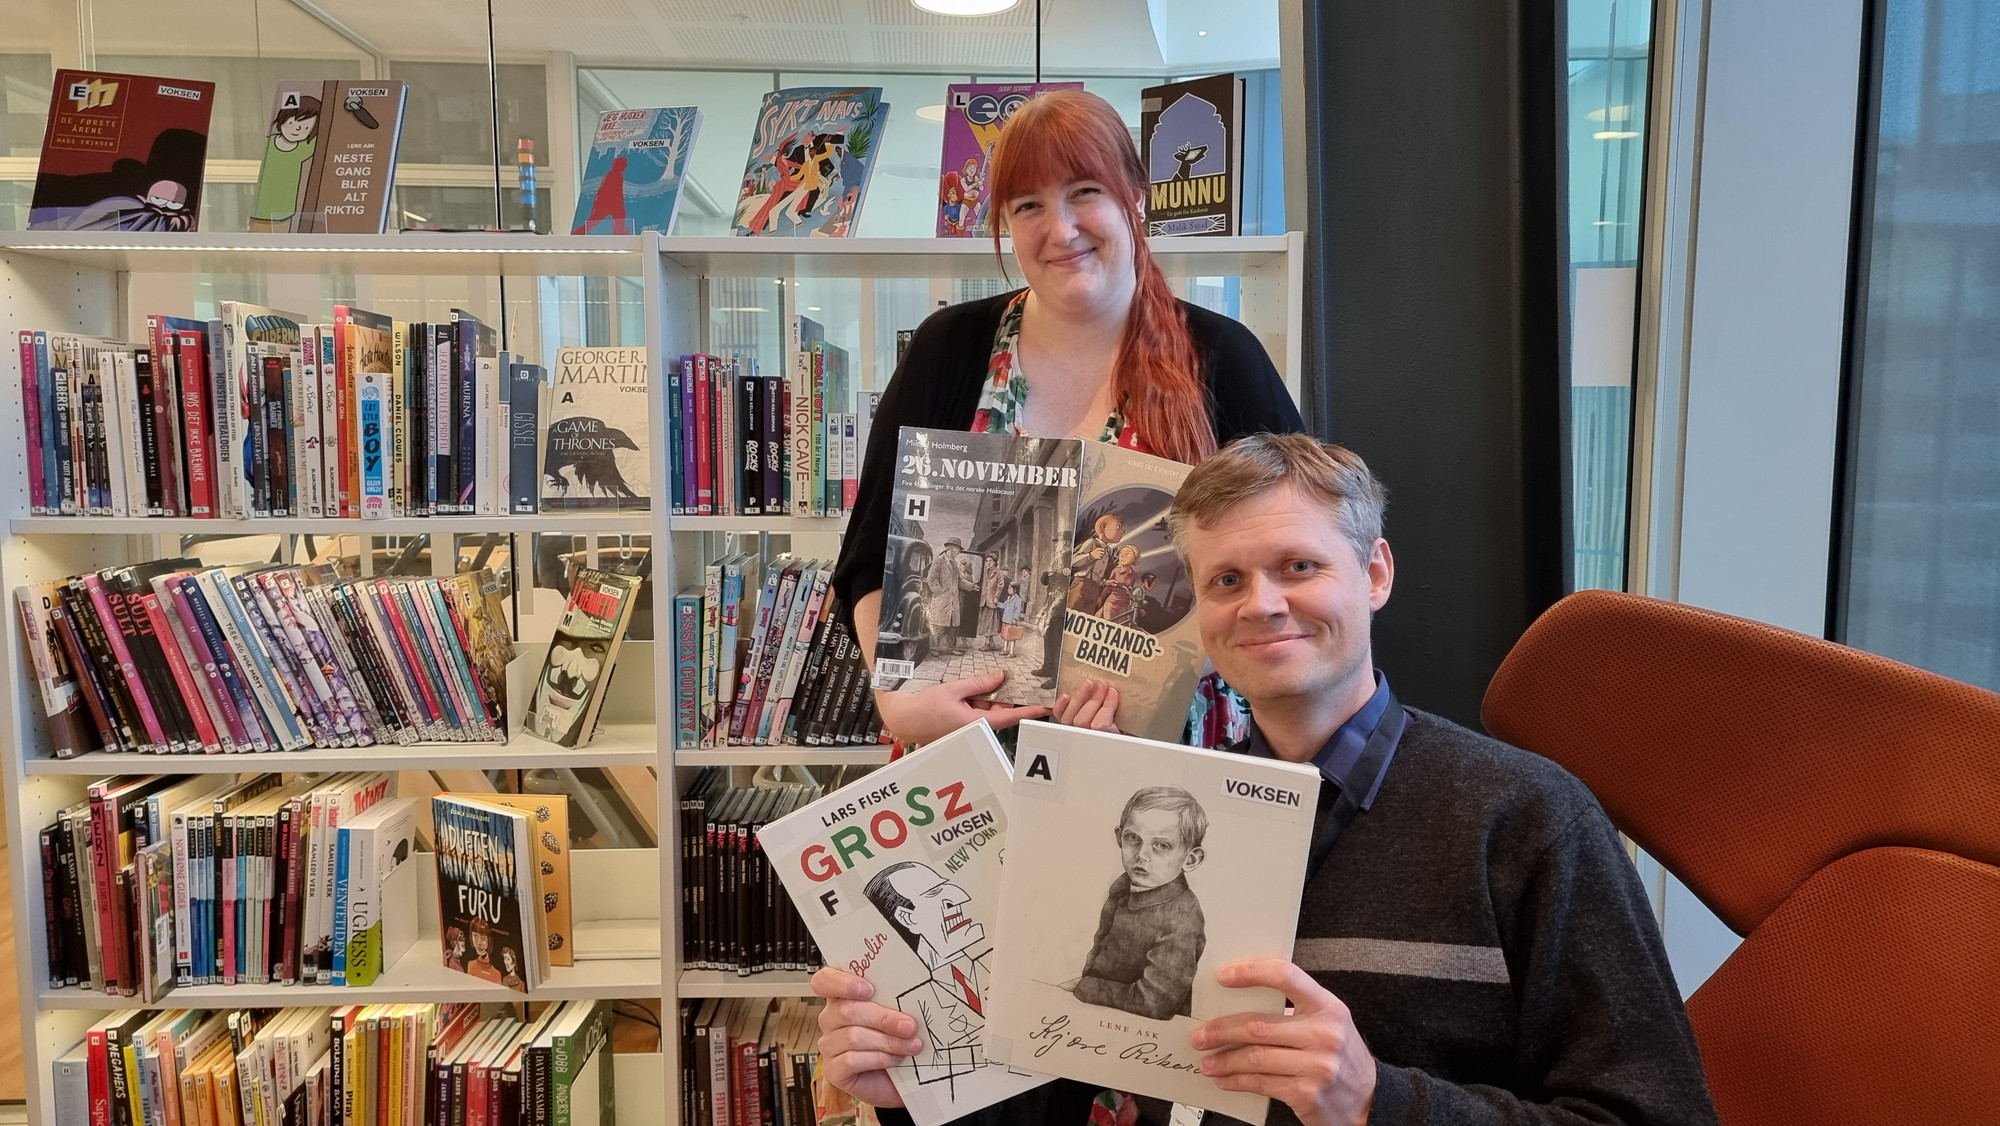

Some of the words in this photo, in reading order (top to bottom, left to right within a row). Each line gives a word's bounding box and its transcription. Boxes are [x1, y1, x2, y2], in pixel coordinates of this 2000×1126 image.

[159, 86, 200, 99] VOKSEN
[284, 94, 298, 108] A
[350, 88, 386, 98] VOKSEN
[955, 93, 966, 106] L
[71, 124, 103, 134] ÅRENE
[80, 118, 118, 128] FØRSTE
[603, 112, 619, 122] JEG
[619, 110, 647, 120] HUSKER
[751, 99, 820, 159] SYKT
[816, 99, 863, 121] NAIS
[80, 139, 114, 148] ERIKSEN
[334, 154, 373, 164] NESTE
[336, 167, 371, 177] GANG
[341, 180, 369, 190] BLIR
[344, 192, 366, 202] ALT
[1152, 176, 1225, 210] MUNNU
[324, 205, 365, 216] RIKTIG
[214, 333, 222, 345] Enki
[303, 337, 315, 366] ERNIE
[322, 337, 334, 364] ERNIE
[438, 349, 448, 370] JEAN
[561, 350, 627, 365] GEORGE
[630, 350, 644, 364] R.
[186, 392, 197, 408] HVIS
[439, 373, 449, 420] MELVILLES
[463, 380, 471, 418] MURENA
[561, 391, 574, 404] A
[619, 385, 648, 394] VOKSE
[188, 412, 199, 425] DET
[216, 372, 229, 462] MONSTER-TETRALOGIEN
[269, 402, 278, 428] DAHMER
[276, 401, 282, 410] MY
[796, 396, 809, 436] NICK
[814, 392, 823, 423] TOTT
[145, 416, 154, 460] HANDMAID'S
[190, 428, 201, 445] IKKE
[439, 422, 449, 450] PROFIL
[513, 412, 535, 449] GISSEL
[556, 420, 599, 434] GAME
[364, 423, 380, 472] BOY
[553, 438, 616, 451] THRONES
[748, 440, 759, 472] ROCKY
[769, 441, 779, 472] ROCKY
[906, 439, 930, 449] Mikl
[931, 442, 968, 453] Holmberg
[191, 448, 204, 482] BRENNER
[796, 438, 809, 481] CAVE
[986, 488, 1015, 496] Holocaust
[908, 499, 926, 516] H
[220, 582, 233, 595] Den
[602, 587, 620, 596] VOKSEN
[20, 600, 38, 640] LOSERS
[107, 593, 136, 637] SULT
[126, 593, 154, 636] SULT
[224, 595, 245, 623] fremmede
[563, 612, 573, 627] M
[680, 612, 696, 662] ESSEX
[820, 612, 835, 644] BATMAN
[1064, 611, 1162, 657] MOTSTANDS-
[225, 622, 237, 641] TRÆR
[234, 642, 244, 653] JEG
[242, 655, 252, 668] HAR
[249, 670, 262, 689] MØTT
[836, 635, 849, 659] LUNCH
[1077, 638, 1129, 674] BARNA
[217, 688, 225, 701] MADS
[680, 667, 696, 731] COUNTY
[1026, 754, 1052, 781] A
[821, 802, 857, 827] LARS
[858, 782, 900, 810] FISKE
[1225, 779, 1301, 807] VOKSEN
[92, 807, 105, 866] MERZ
[800, 781, 973, 882] GROSZ
[931, 811, 994, 846] VOKSEN
[289, 842, 297, 858] TYVER
[448, 824, 498, 865] DUFTEN
[175, 839, 184, 880] NORRØNE
[289, 859, 296, 867] OG
[309, 843, 318, 875] SAMLEDE
[327, 843, 335, 875] SAMLEDE
[944, 846, 971, 874] NEW
[309, 878, 317, 898] VERK
[326, 878, 334, 898] VERK
[466, 863, 483, 888] AV
[177, 882, 186, 910] GUDER
[458, 884, 501, 924] FURU
[819, 889, 840, 917] F
[334, 878, 348, 957] VENTETIDEN
[350, 901, 368, 967] UGRESS
[849, 932, 889, 978] Berlin
[1099, 1020, 1130, 1033] LENE
[1136, 1029, 1159, 1040] ASK
[555, 1048, 568, 1073] JOBB
[714, 1040, 724, 1055] JOE
[107, 1042, 126, 1099] MEGAHEKS
[715, 1058, 725, 1082] SACCO
[557, 1083, 568, 1114] ANDERS
